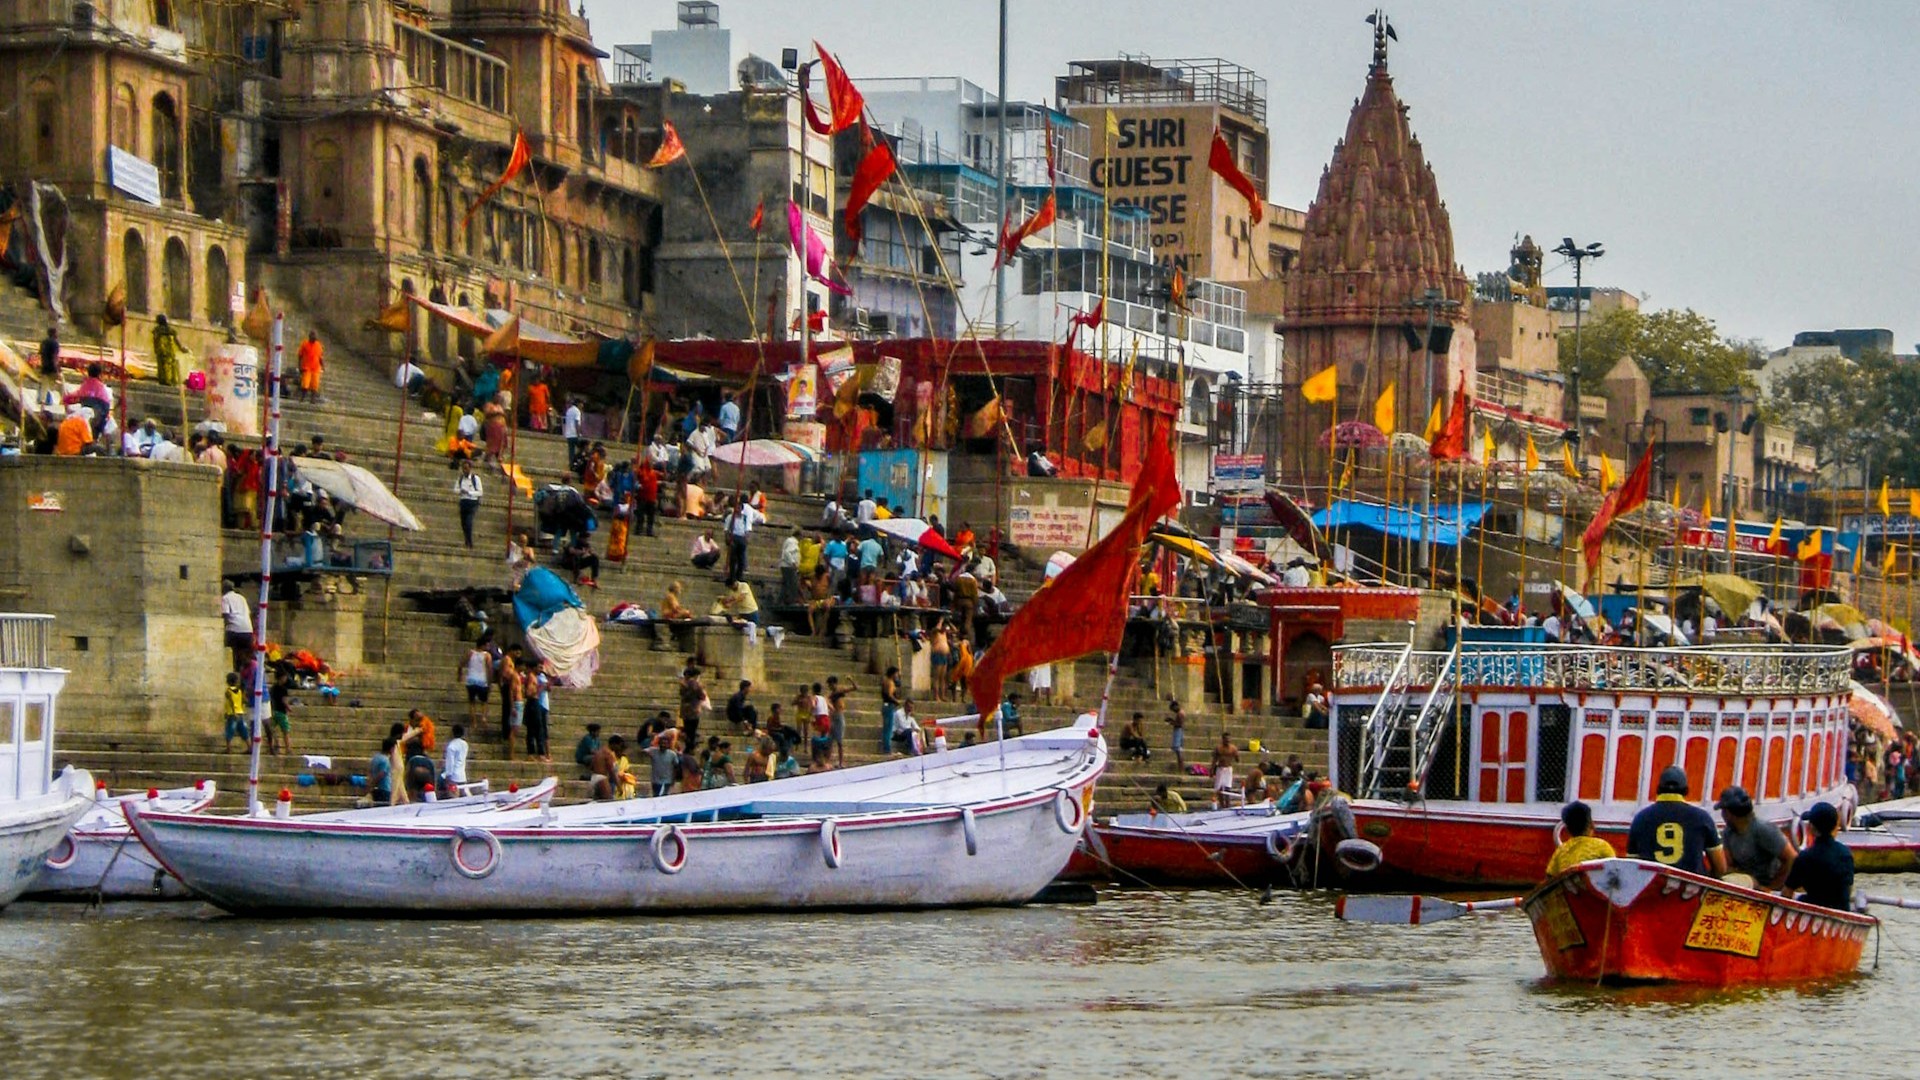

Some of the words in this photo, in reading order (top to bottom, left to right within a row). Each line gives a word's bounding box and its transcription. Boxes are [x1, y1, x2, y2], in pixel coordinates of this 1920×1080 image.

[1118, 118, 1185, 148] SHRI
[1090, 156, 1192, 188] GUEST
[1654, 822, 1684, 865] 9
